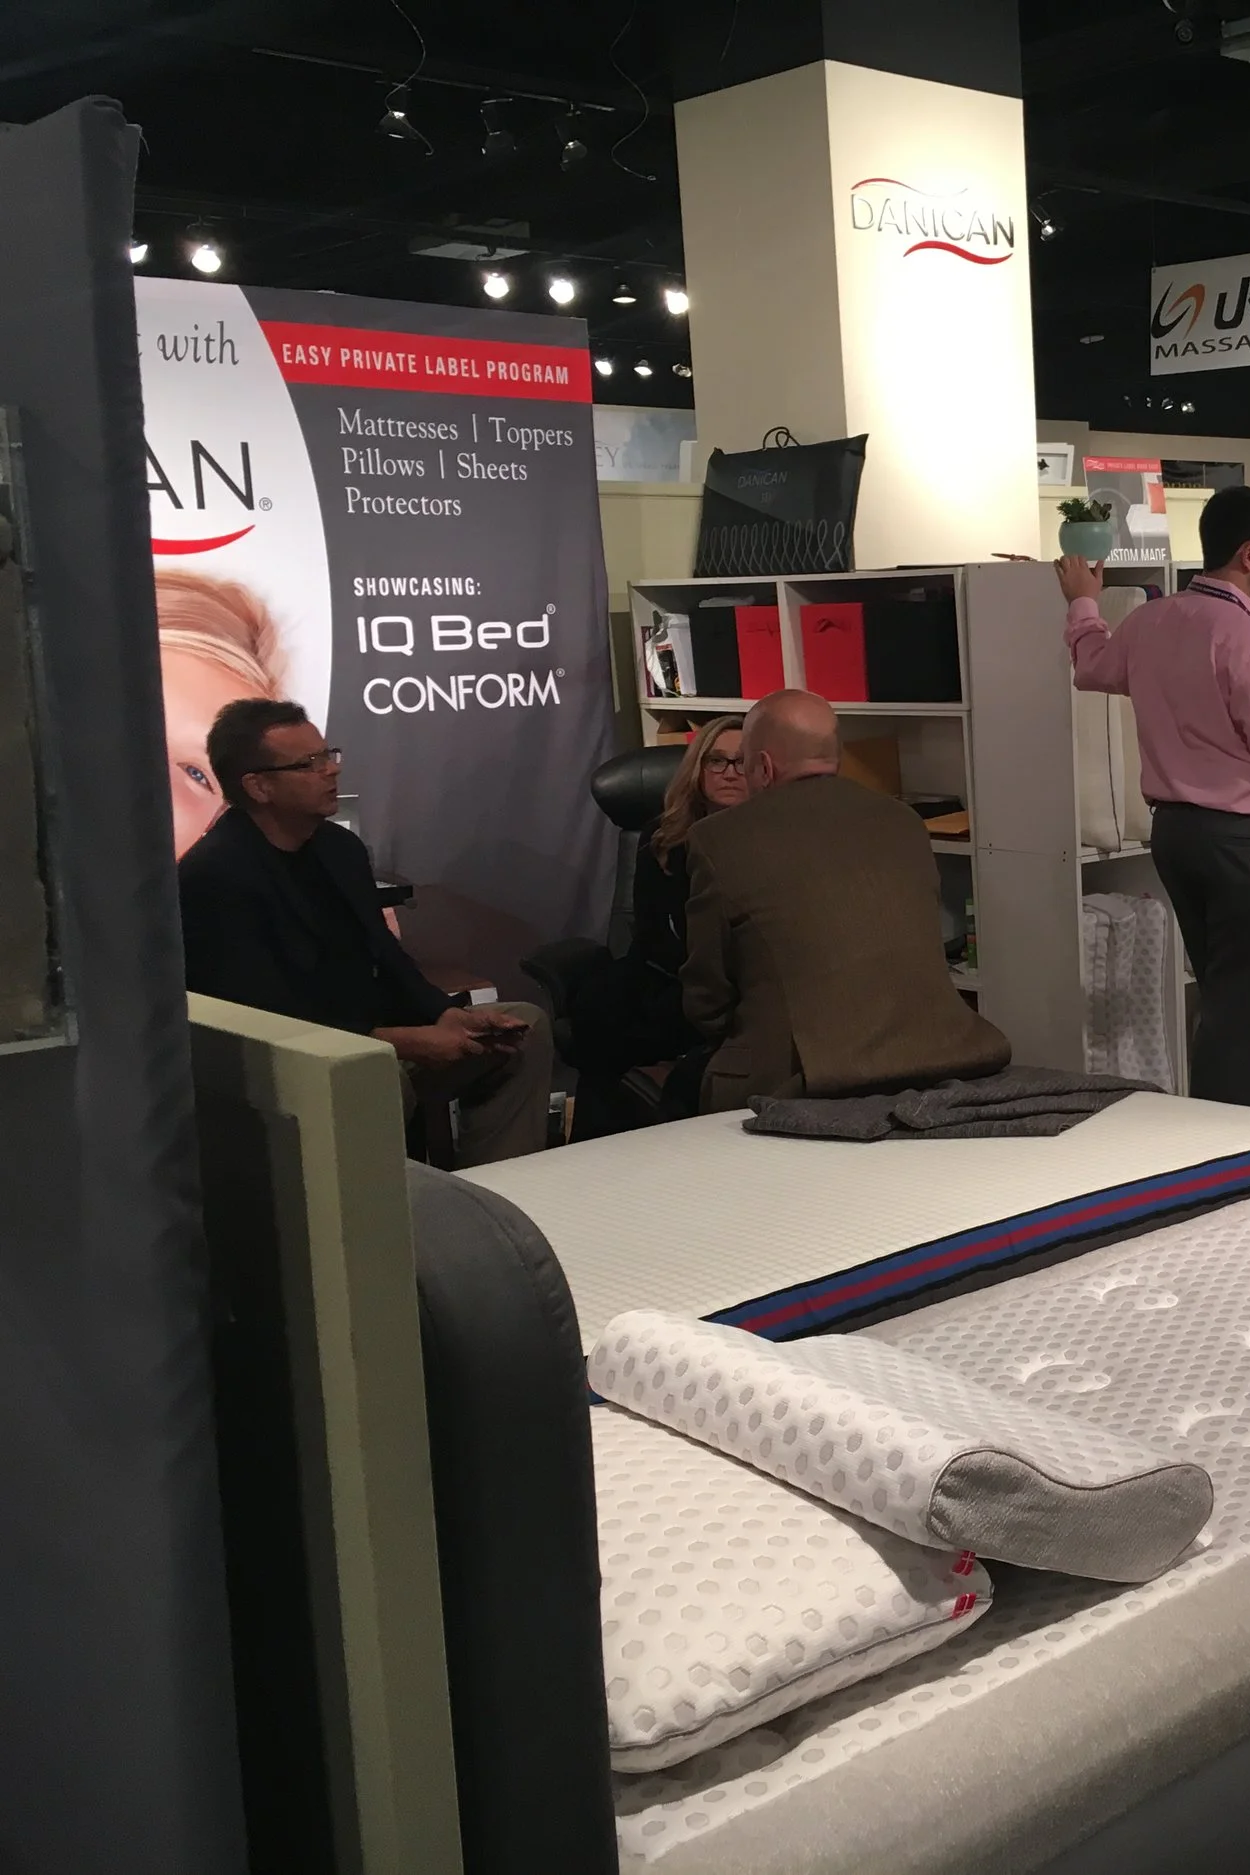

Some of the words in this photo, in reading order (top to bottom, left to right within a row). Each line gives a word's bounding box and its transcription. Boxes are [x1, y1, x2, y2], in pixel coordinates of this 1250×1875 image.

[851, 194, 1014, 248] DANICAN
[157, 321, 239, 365] with
[282, 343, 332, 366] EASY
[340, 347, 418, 374] PRIVATE
[425, 356, 480, 379] LABEL
[486, 361, 569, 385] PROGRAM
[337, 407, 459, 441] Mattresses
[488, 417, 574, 451] Toppers
[342, 447, 425, 478] Pillows
[457, 453, 528, 481] Sheets
[345, 487, 462, 516] Protectors
[1140, 547, 1167, 561] MADE
[353, 577, 482, 597] SHOWCASING:
[357, 616, 415, 657] IQ
